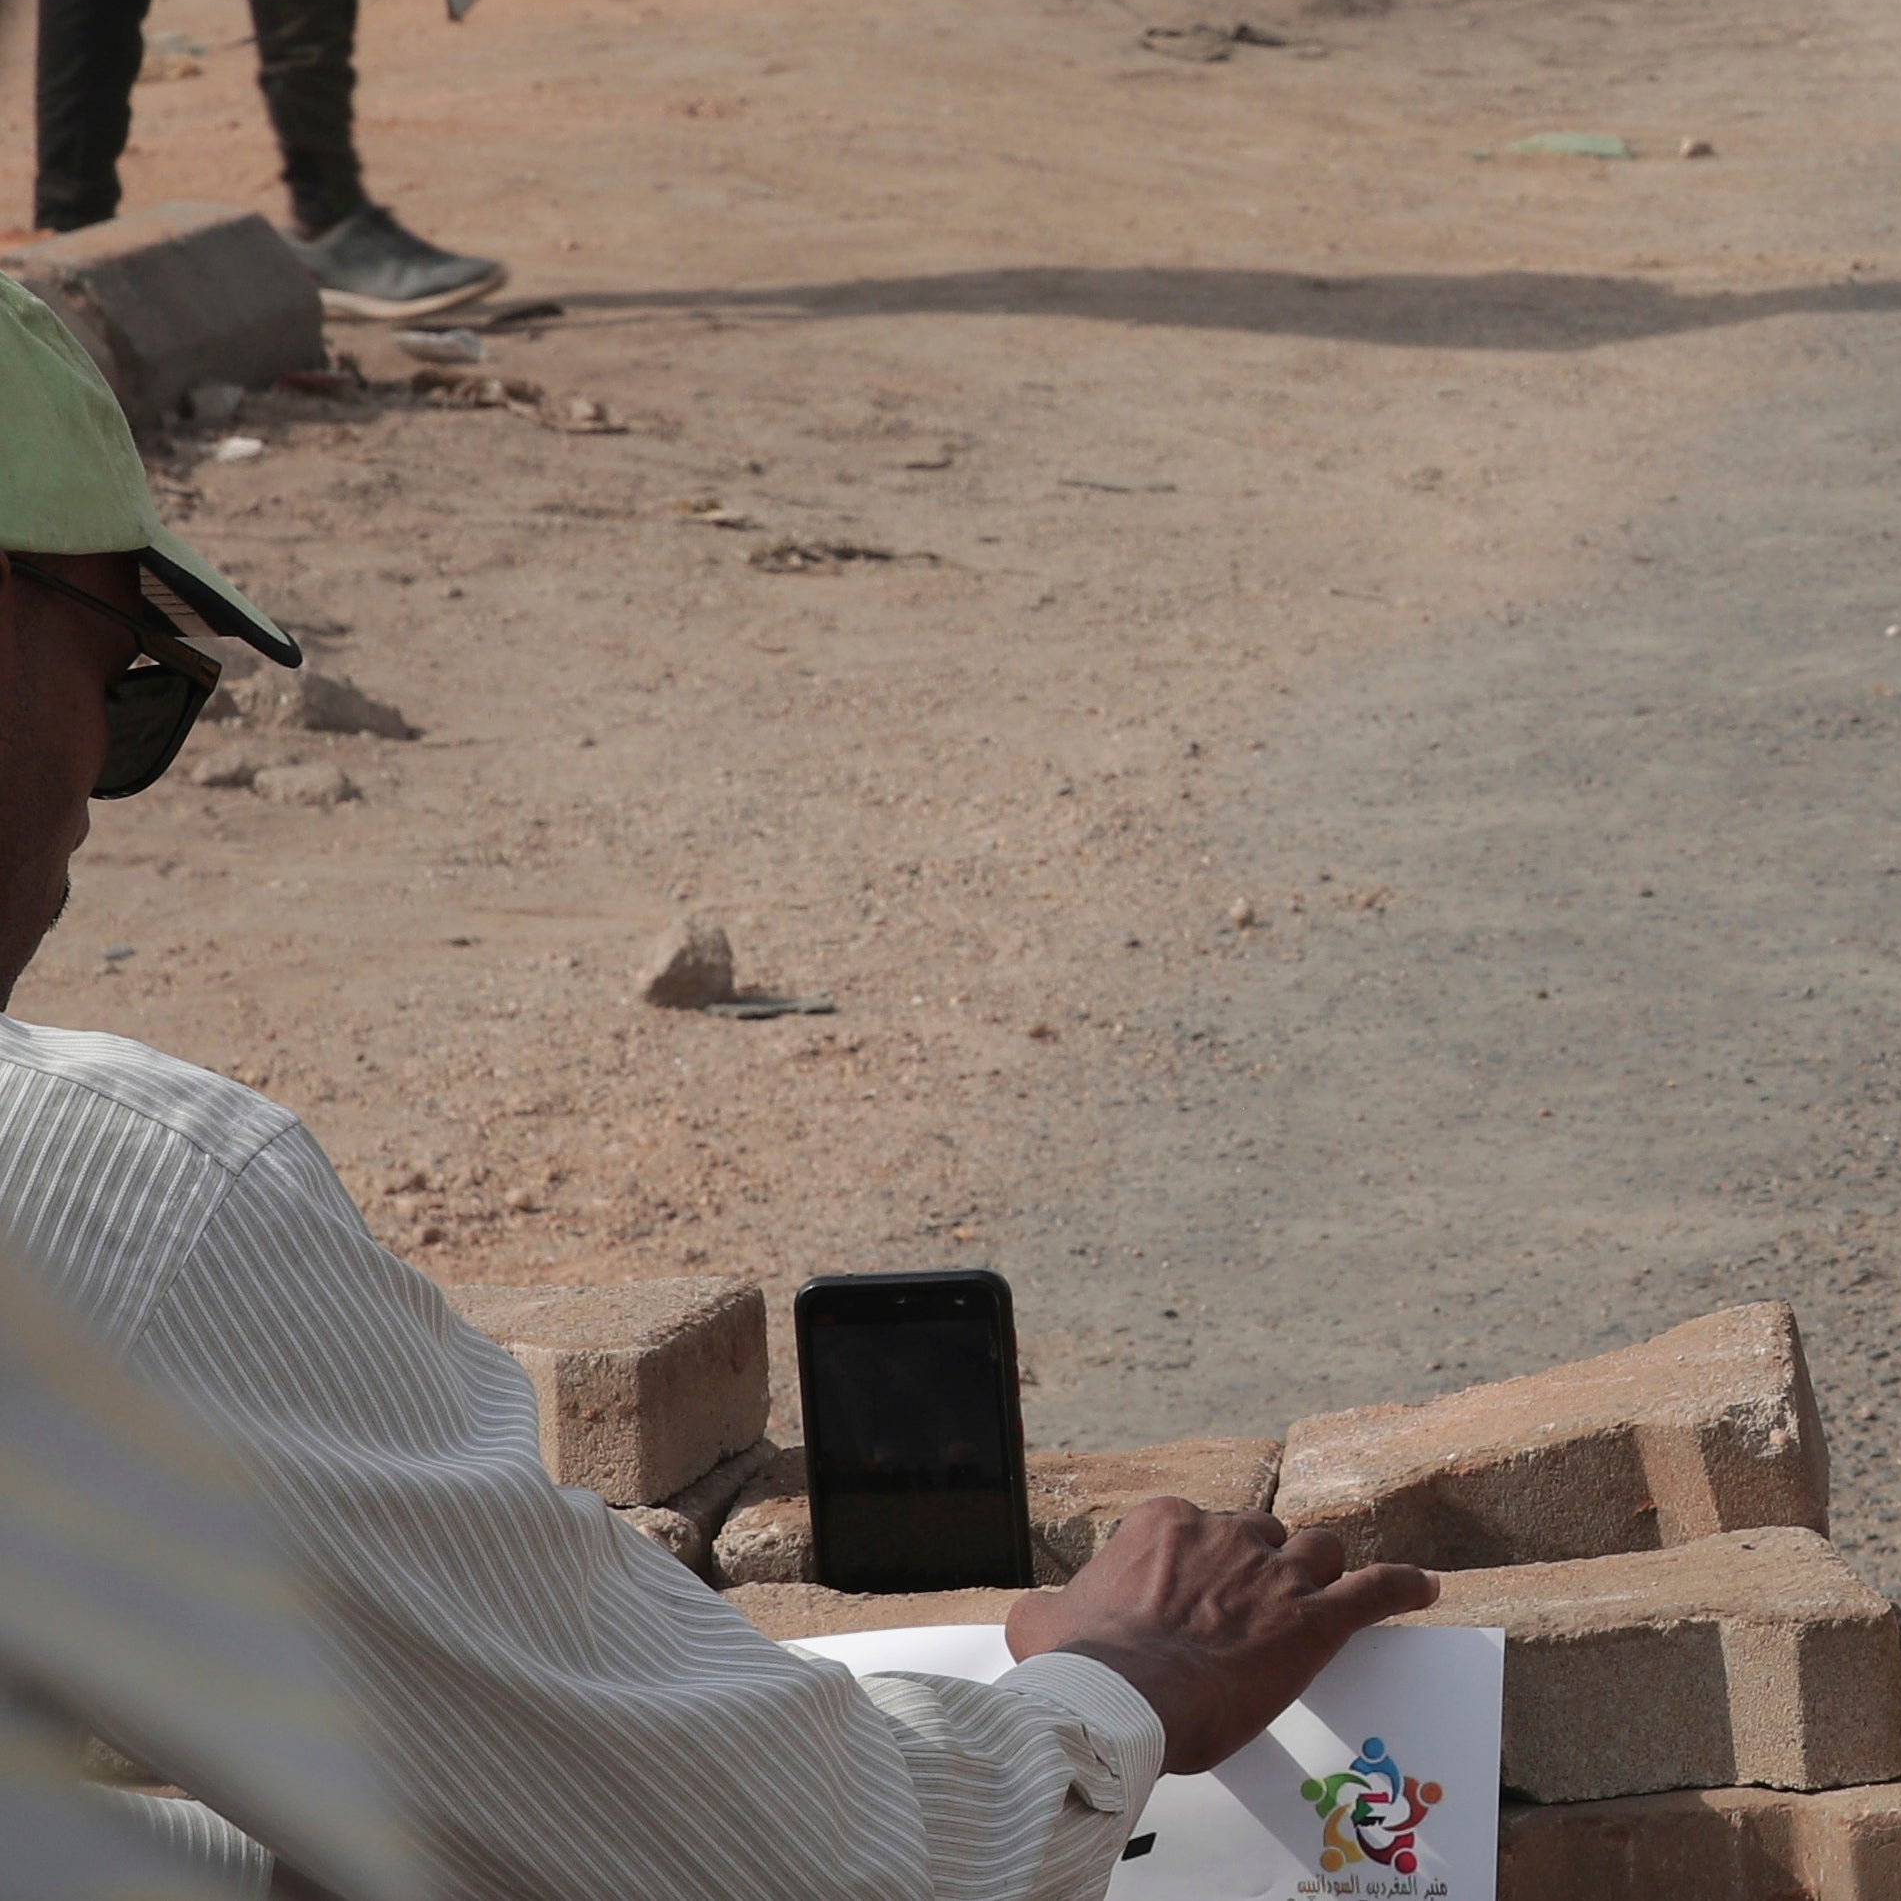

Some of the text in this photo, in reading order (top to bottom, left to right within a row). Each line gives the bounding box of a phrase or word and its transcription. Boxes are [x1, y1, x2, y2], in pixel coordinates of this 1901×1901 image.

[1296, 1874, 1448, 1900] منبر المغردين السودانيين
